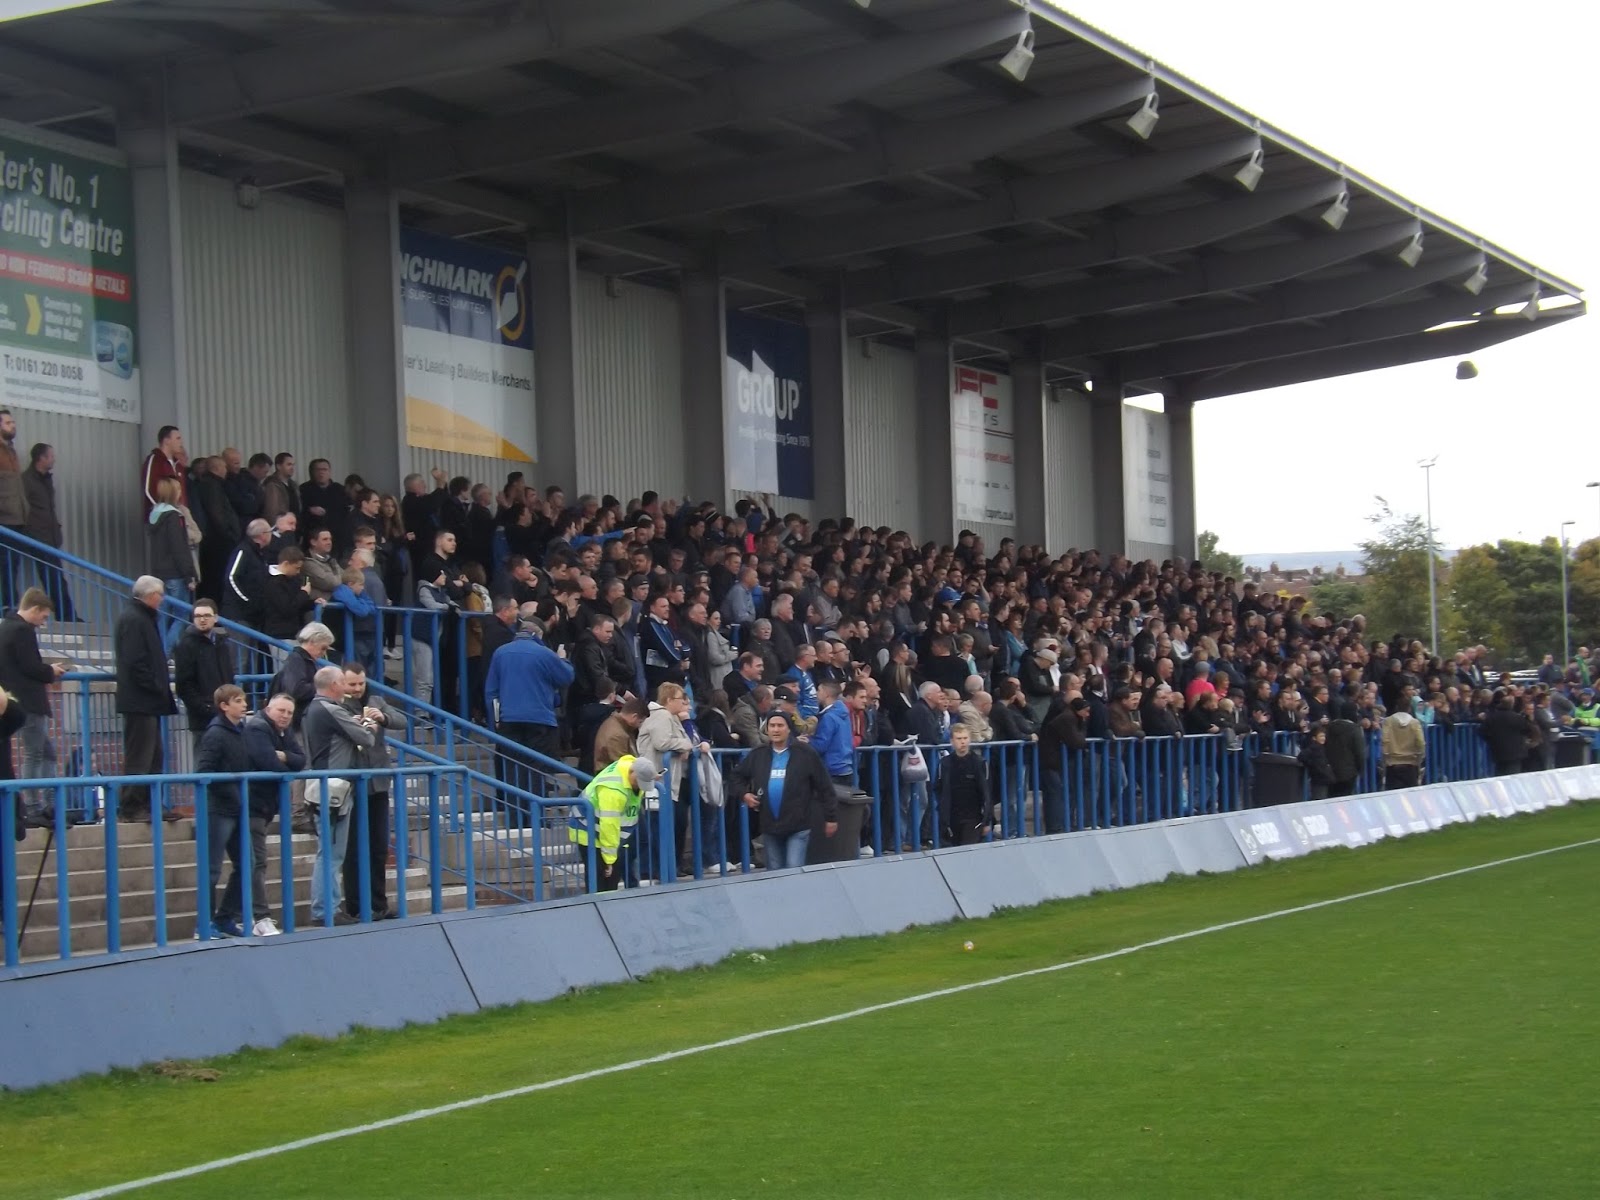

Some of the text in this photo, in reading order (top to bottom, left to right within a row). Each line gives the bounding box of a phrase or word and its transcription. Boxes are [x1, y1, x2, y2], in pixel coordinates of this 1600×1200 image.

[49, 162, 81, 204] No.
[89, 174, 99, 208] 1
[1, 198, 123, 257] cling Centre
[95, 273, 126, 296] METALS
[15, 356, 38, 374] 0161
[41, 360, 58, 377] 220
[60, 364, 84, 381] 8058
[424, 356, 455, 381] Leading
[457, 363, 489, 383] Builders
[738, 369, 800, 421] GROUP
